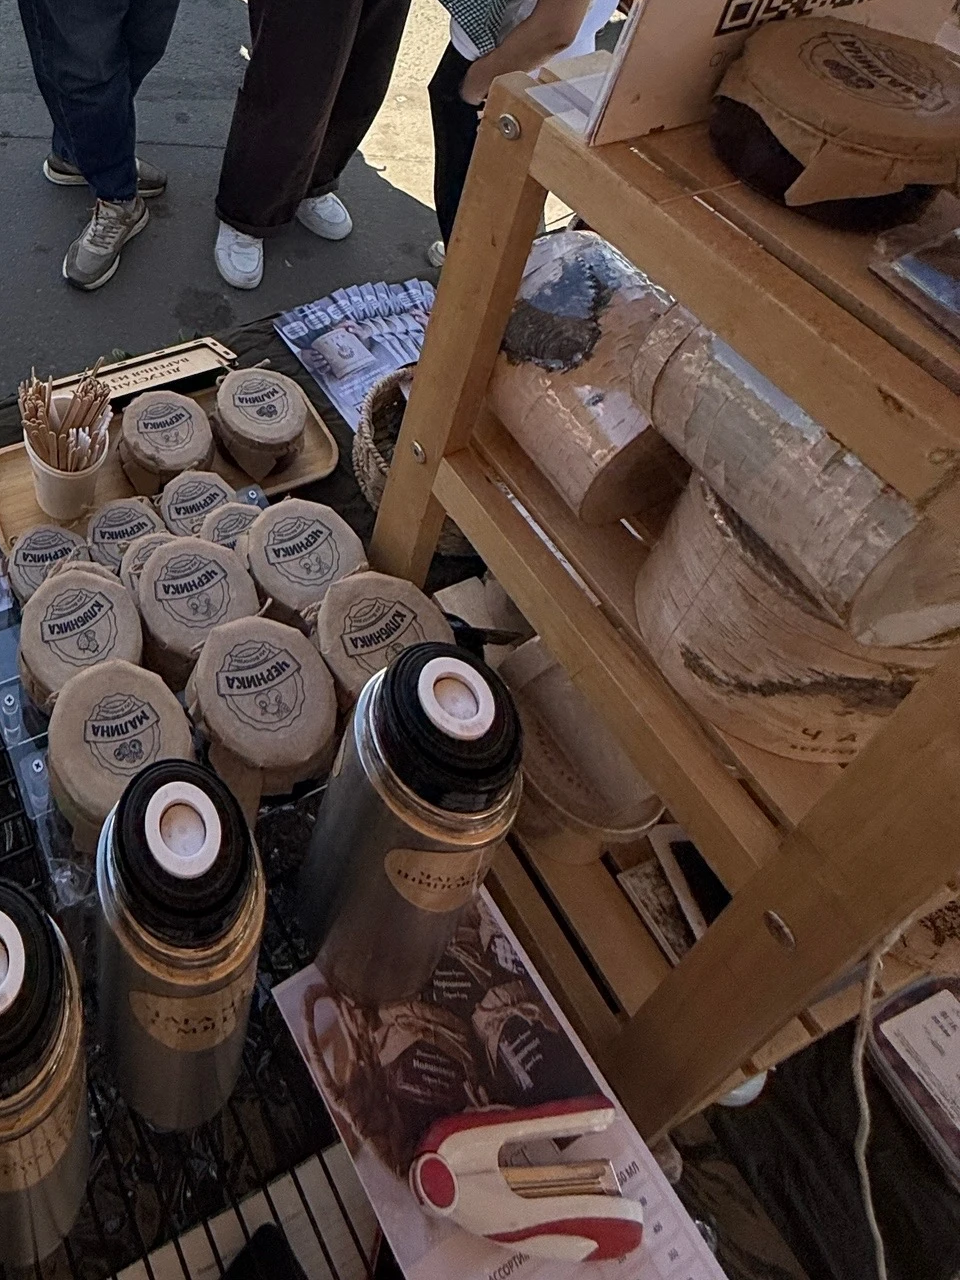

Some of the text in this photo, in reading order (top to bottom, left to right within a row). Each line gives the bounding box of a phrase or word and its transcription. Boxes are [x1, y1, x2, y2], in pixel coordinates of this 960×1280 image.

[110, 366, 181, 391] ДЕГУСТАЦ
[132, 357, 190, 377] ВАРЕНЬЯ
[238, 388, 279, 404] МАЛИНА
[143, 412, 186, 430] ЧЕРНИКА
[175, 492, 220, 515] ЧЕРНИКА
[99, 522, 148, 540] ЧЕРНИКА
[272, 529, 324, 558] ЧЕРНИКА
[22, 546, 72, 564] ЧЕРНИКА
[162, 568, 218, 595] ЧЕРНИКА
[48, 600, 104, 635] КЛУБНИКА
[349, 610, 407, 649] КЛУБНИКА
[224, 660, 291, 689] ЧЕРНИКА
[91, 709, 150, 737] МАЛИНА
[487, 1251, 531, 1280] АССОРТИ
